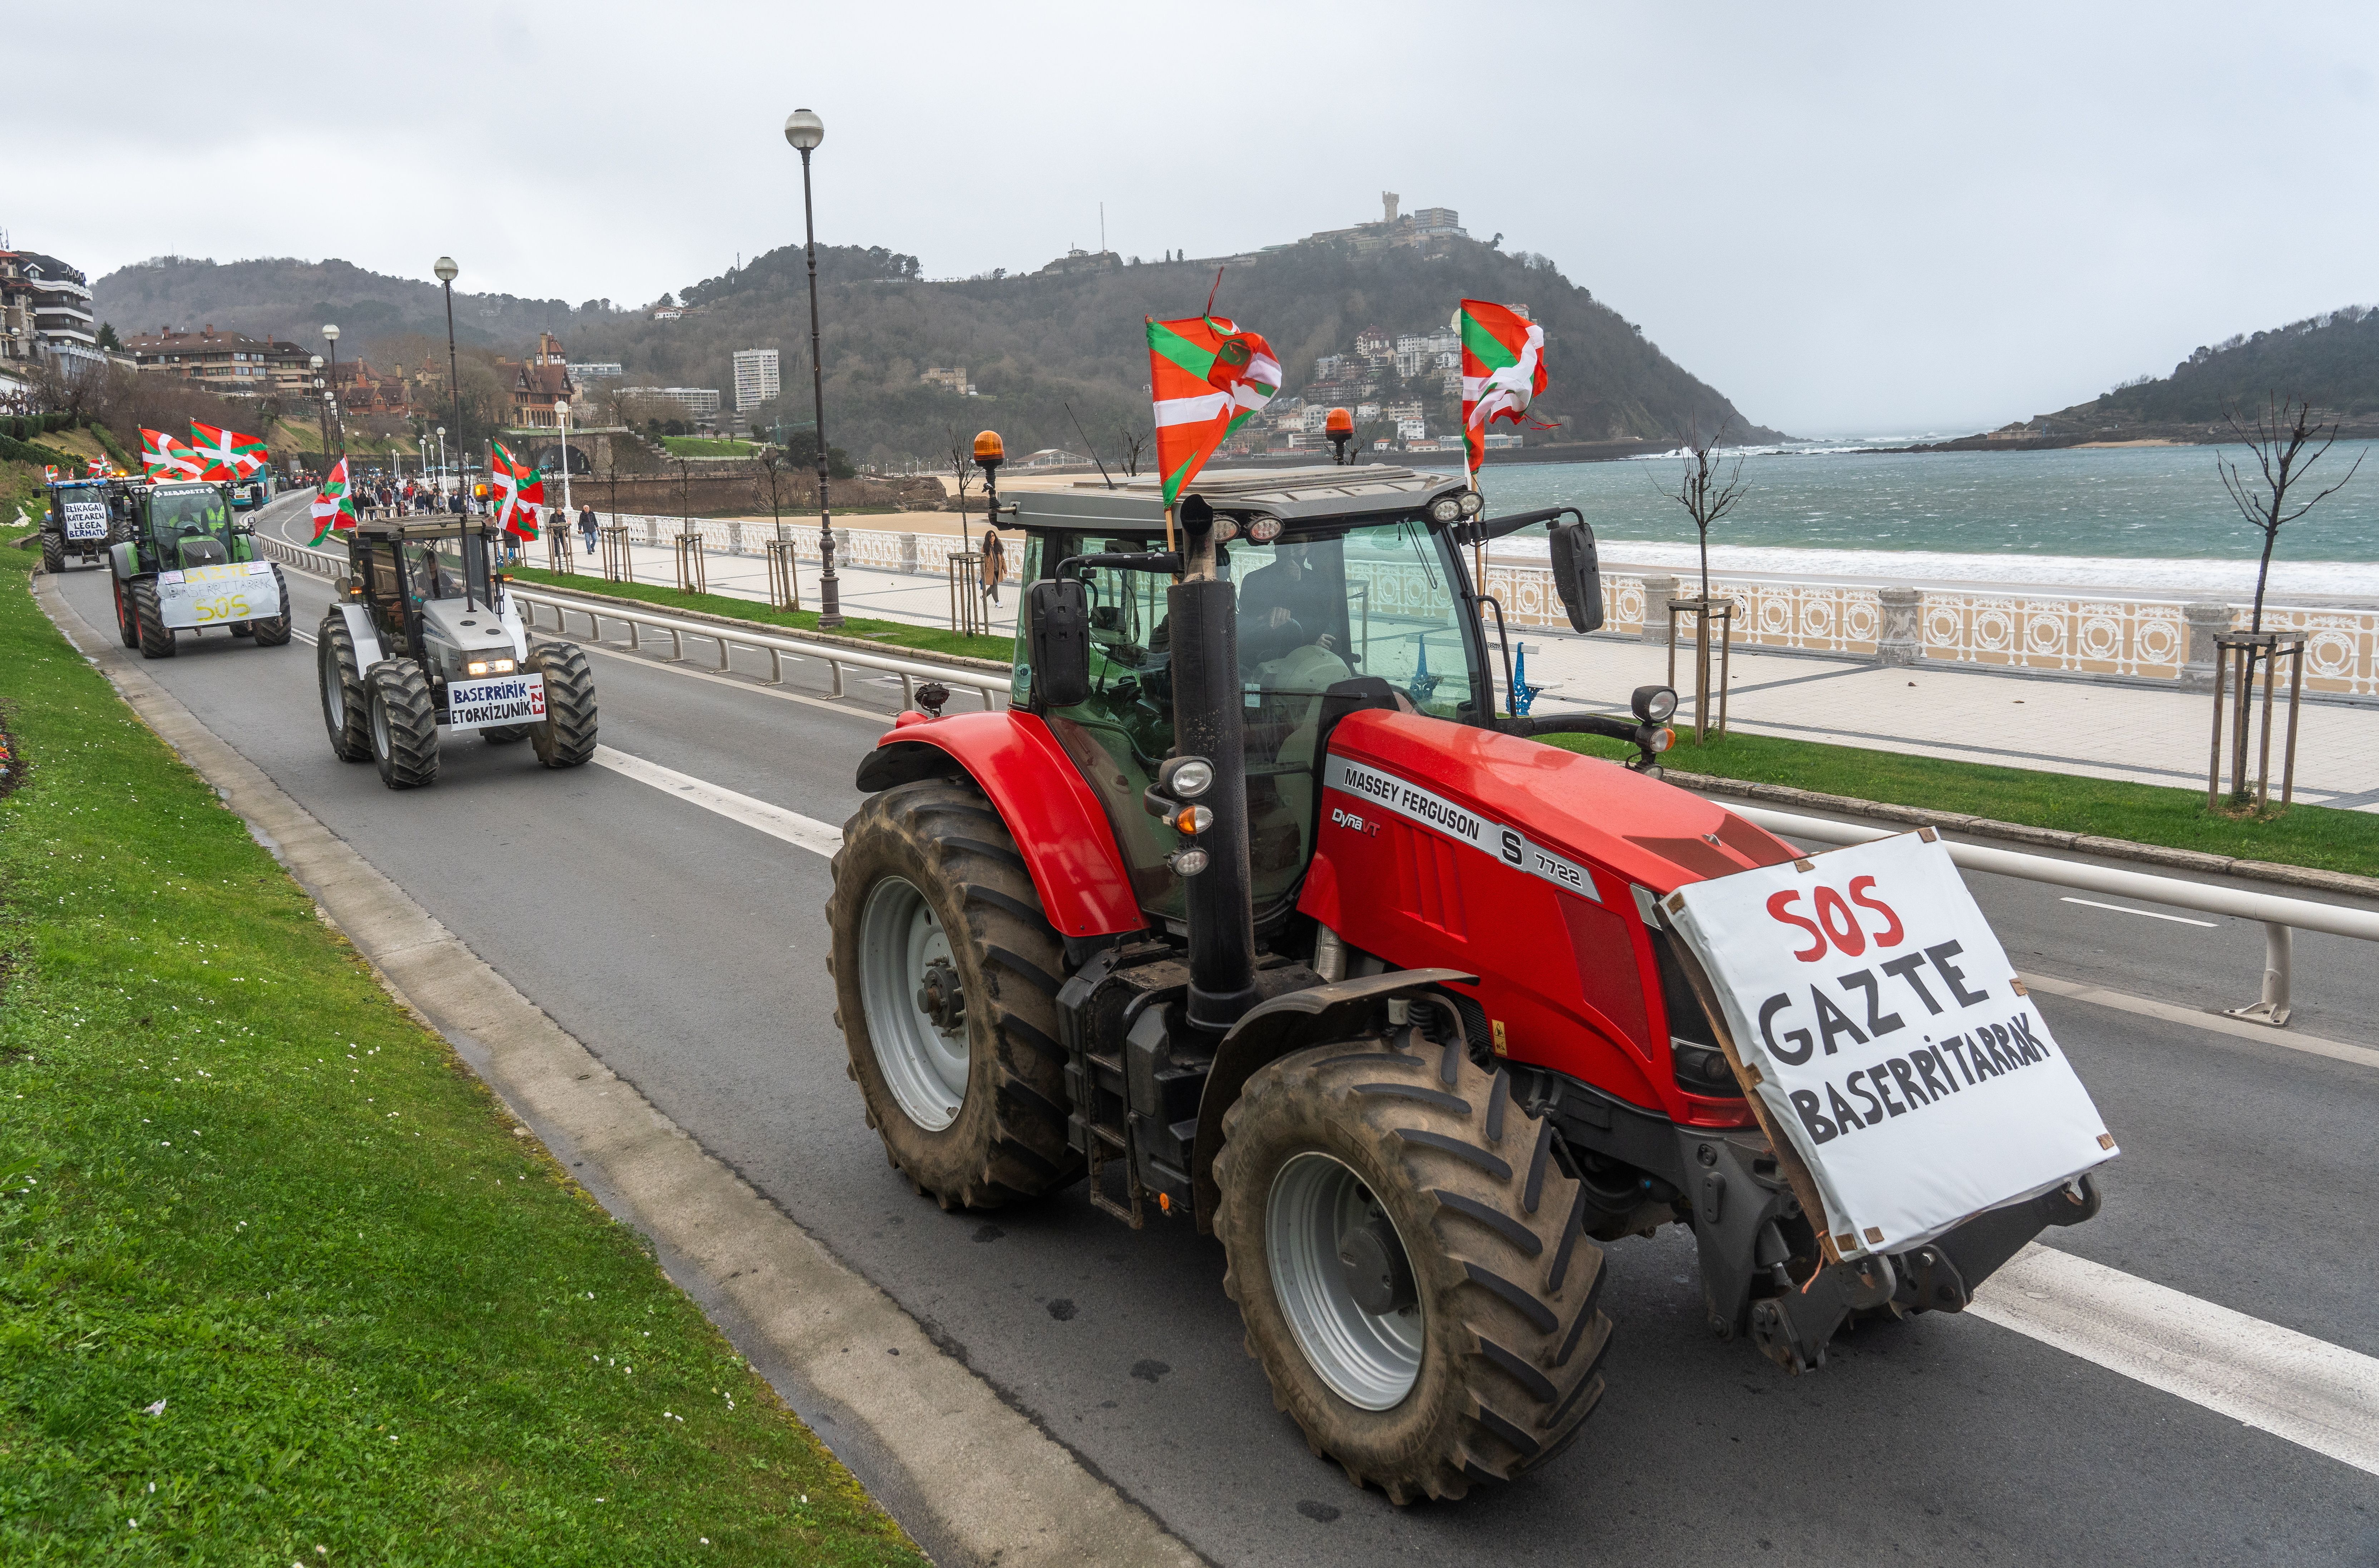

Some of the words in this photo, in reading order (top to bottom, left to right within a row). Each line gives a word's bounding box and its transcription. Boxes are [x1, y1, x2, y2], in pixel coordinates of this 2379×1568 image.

[66, 504, 102, 512] ELIKAGAI
[67, 513, 104, 522] KATEAREN
[69, 529, 105, 537] BERMATU
[183, 563, 251, 583] GAZTE
[169, 579, 273, 600] BASERRITARRAK
[193, 595, 250, 621] SOS
[453, 680, 527, 704] BASERRIRIK
[451, 699, 532, 724] ETORKIZUNIK
[1332, 808, 1380, 836] DynaVT
[1344, 768, 1400, 803] MASSEY
[1402, 789, 1480, 841] FERGUSON
[1501, 830, 1523, 866] S
[1535, 853, 1582, 888] 7722
[1766, 876, 1904, 962] SOS
[1759, 939, 1990, 1066] GAZTE
[1788, 1012, 2051, 1145] BASERRITARRAK
